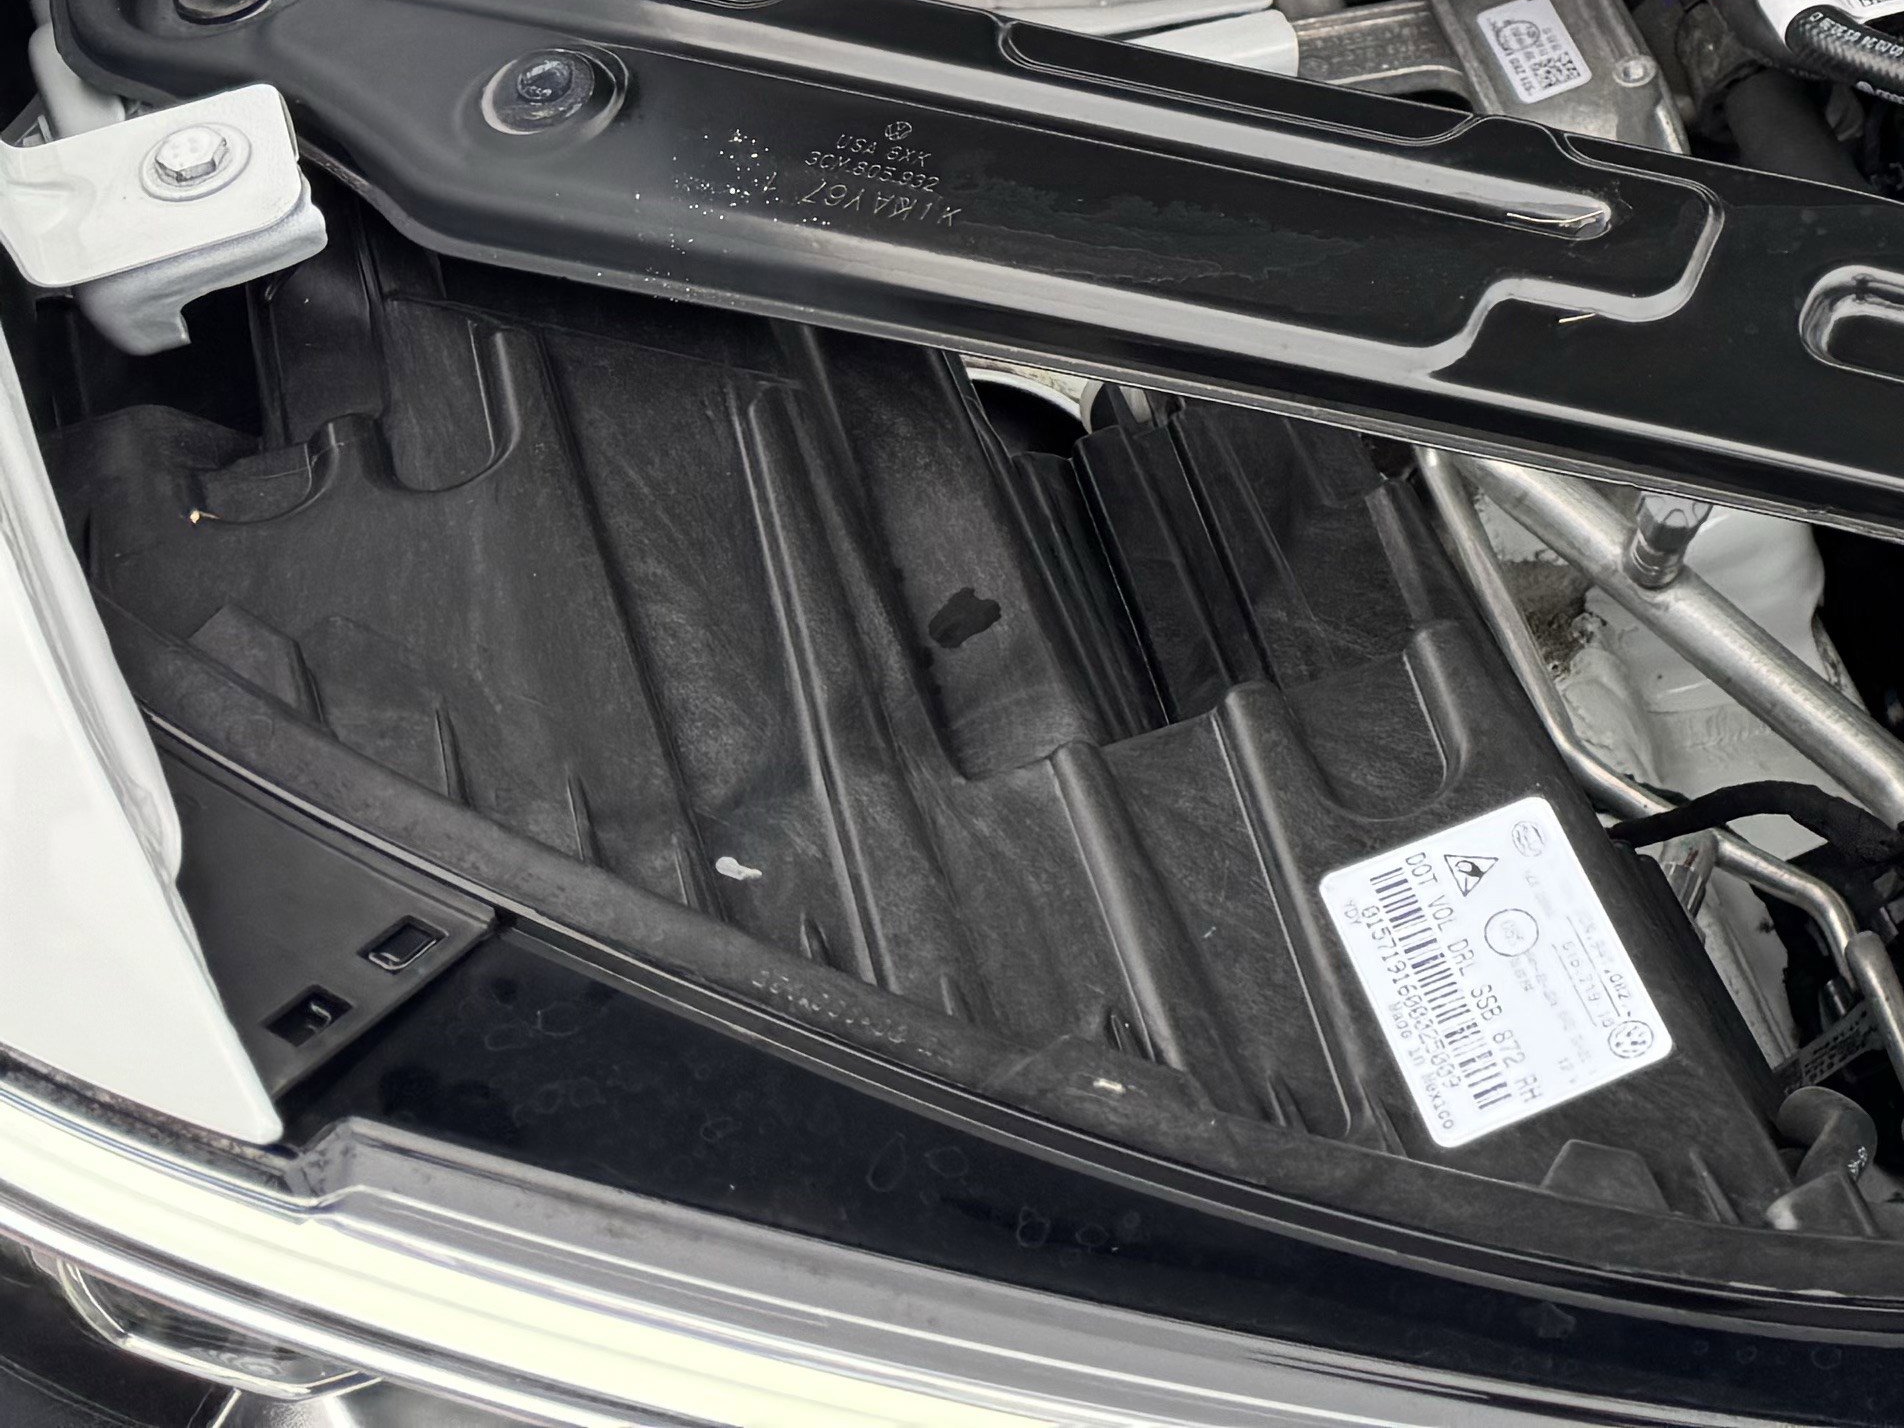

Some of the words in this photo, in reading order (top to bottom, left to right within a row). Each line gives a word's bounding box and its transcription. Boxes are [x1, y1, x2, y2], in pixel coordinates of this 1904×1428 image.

[1404, 851, 1438, 889] DOT
[1425, 894, 1460, 931] VOL
[1469, 982, 1505, 1022] SSB
